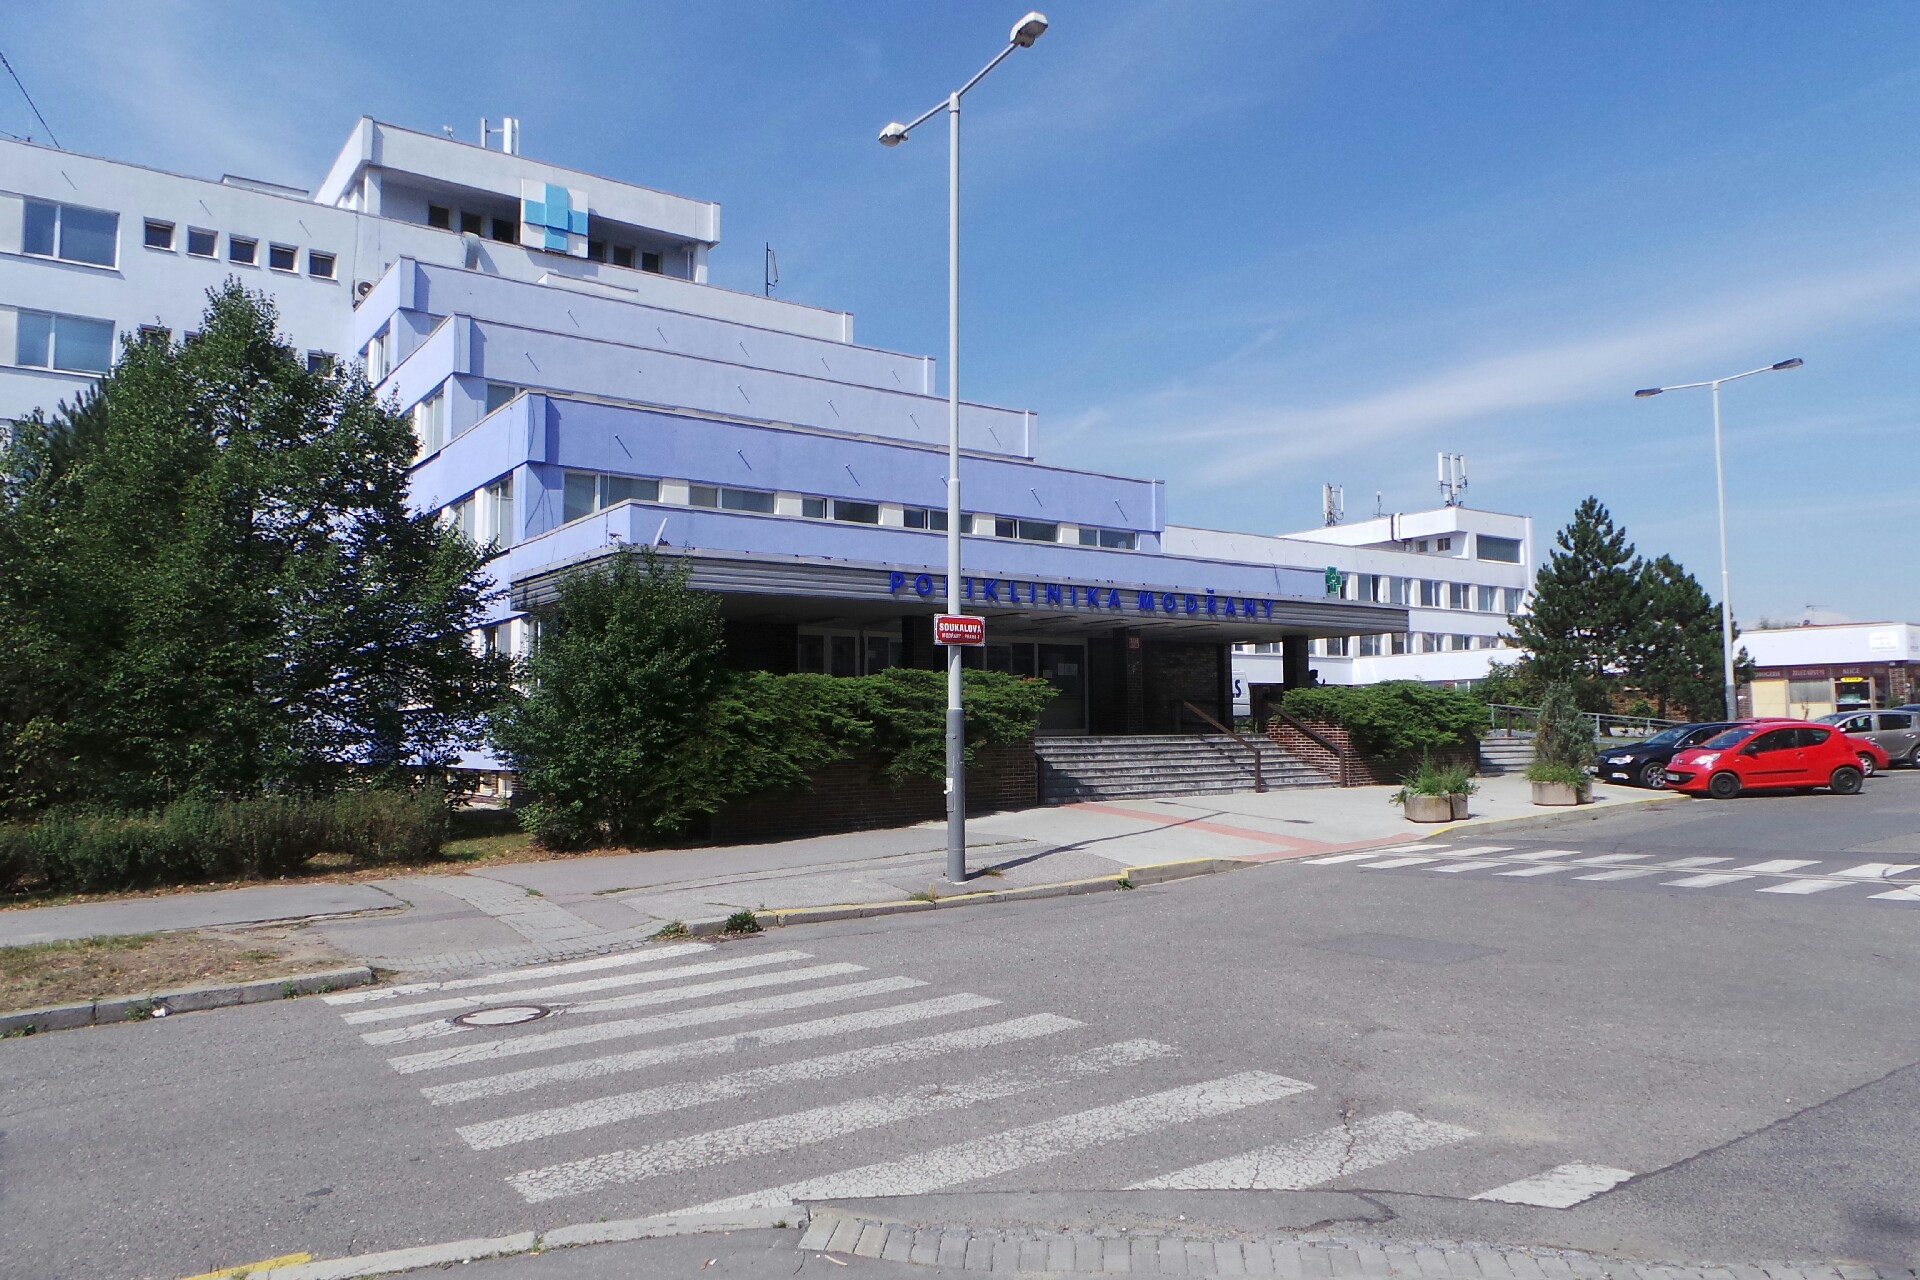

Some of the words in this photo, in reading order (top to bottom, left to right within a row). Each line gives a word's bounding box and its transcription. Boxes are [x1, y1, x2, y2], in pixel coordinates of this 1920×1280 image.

[890, 571, 1121, 608] POIKLINIKA
[1137, 588, 1275, 617] MODŘANY
[939, 622, 982, 633] SOUKALOVA
